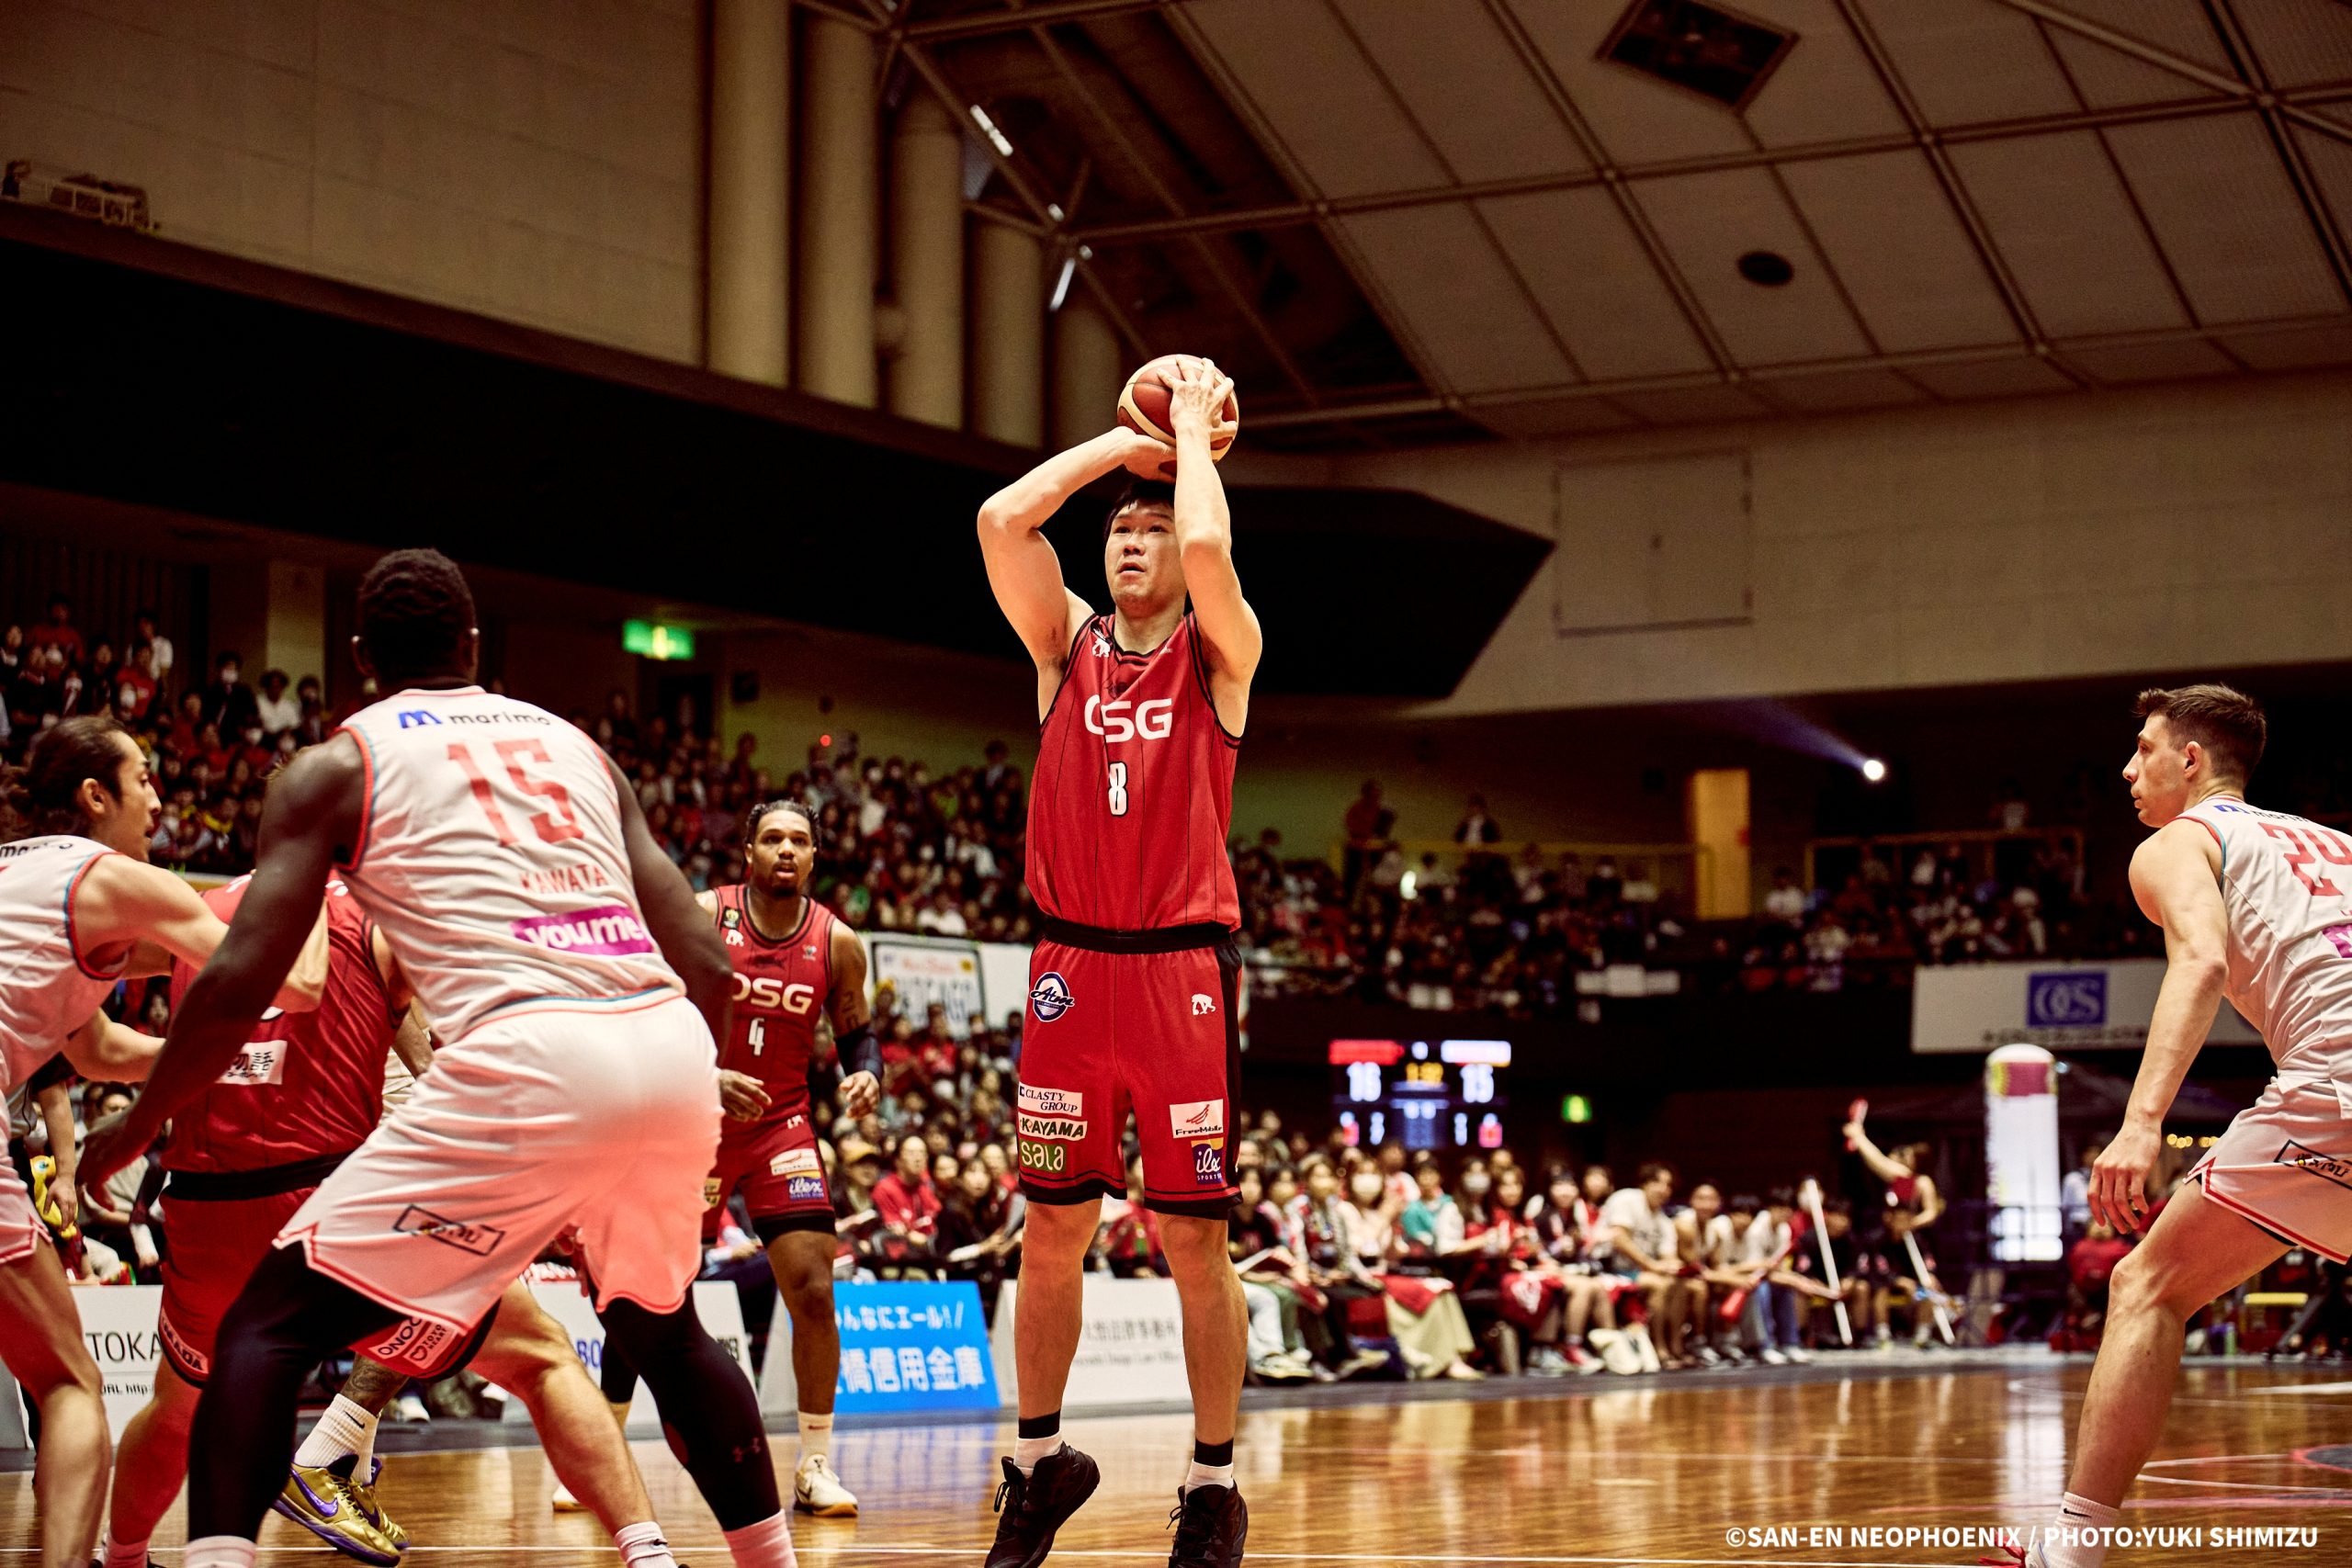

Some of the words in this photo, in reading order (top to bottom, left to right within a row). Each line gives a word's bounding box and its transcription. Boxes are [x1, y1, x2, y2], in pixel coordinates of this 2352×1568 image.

[449, 711, 551, 726] marimo
[447, 739, 583, 847] 15
[1108, 762, 1127, 816] 8
[748, 1017, 765, 1056] 4
[1025, 1089, 1066, 1101] CLASTY
[1040, 1101, 1079, 1113] GROUP
[835, 1345, 987, 1394] 橋信用金庫
